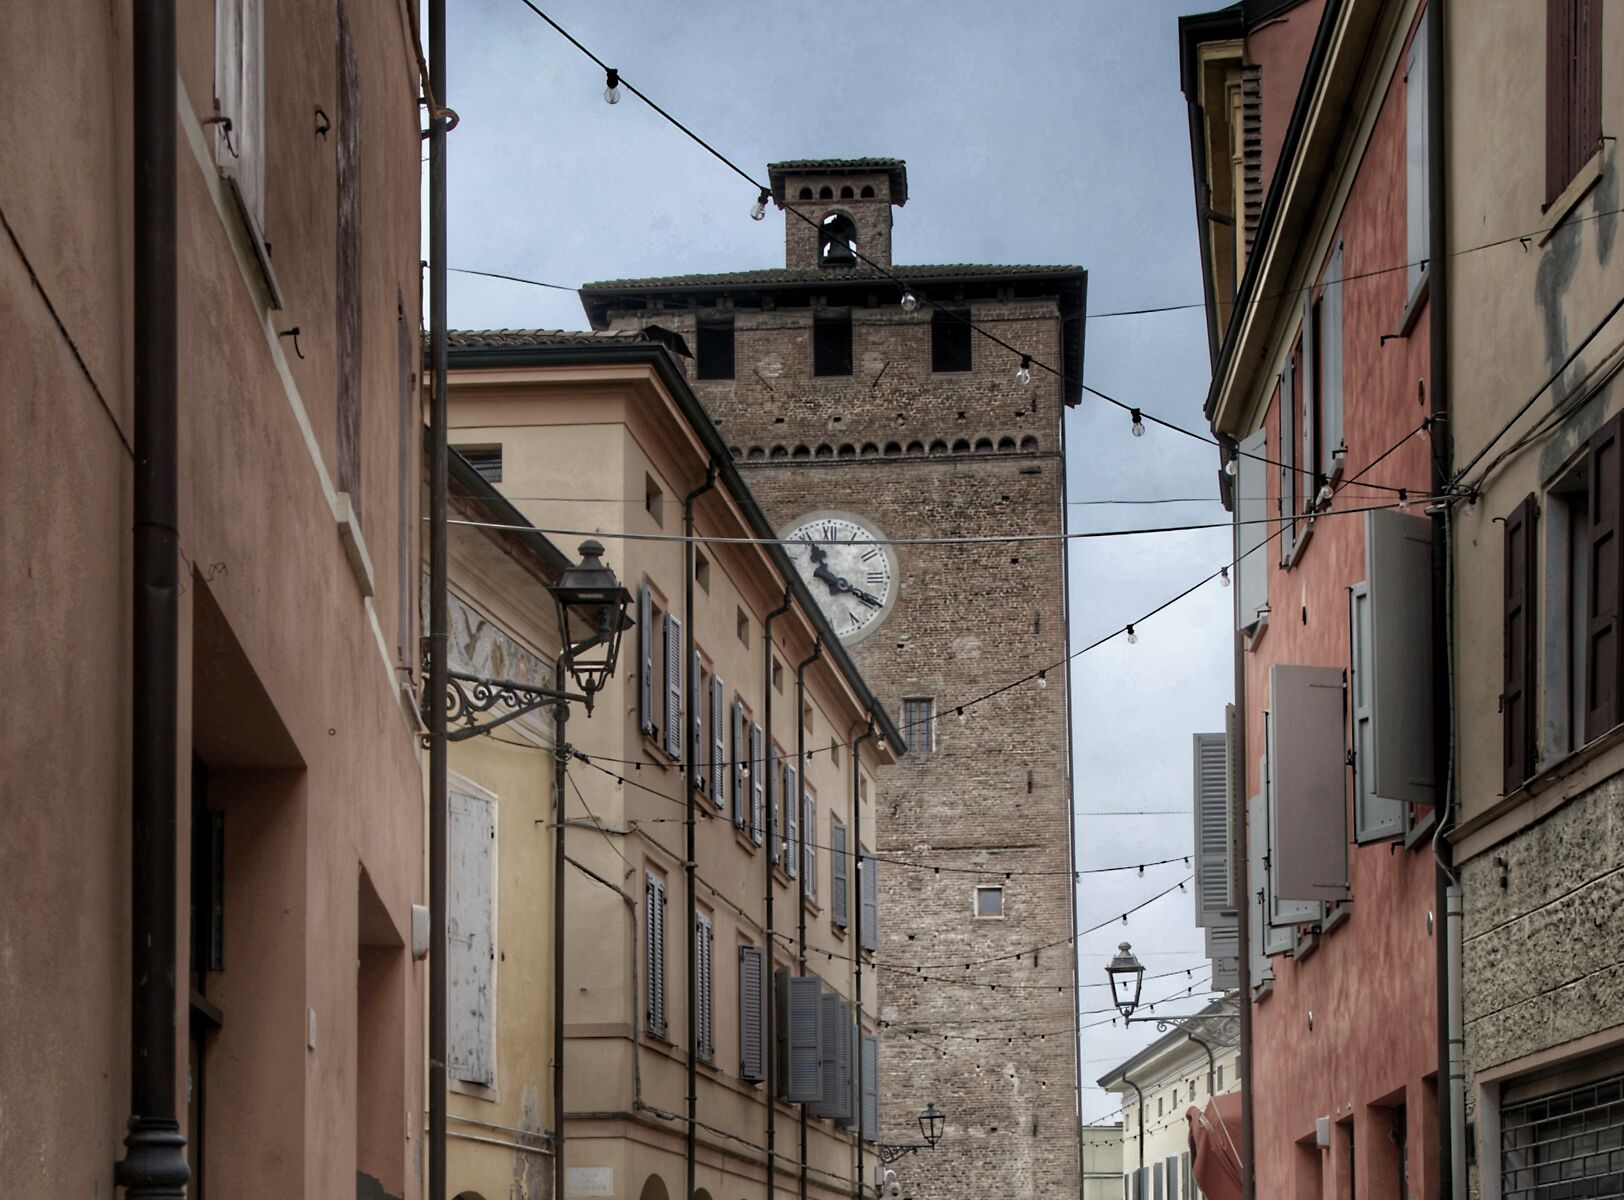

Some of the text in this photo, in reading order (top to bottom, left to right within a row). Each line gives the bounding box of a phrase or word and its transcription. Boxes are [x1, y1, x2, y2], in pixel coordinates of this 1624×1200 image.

[822, 526, 837, 542] XII
[861, 549, 878, 562] II
[867, 572, 884, 584] III
[849, 611, 859, 626] V
